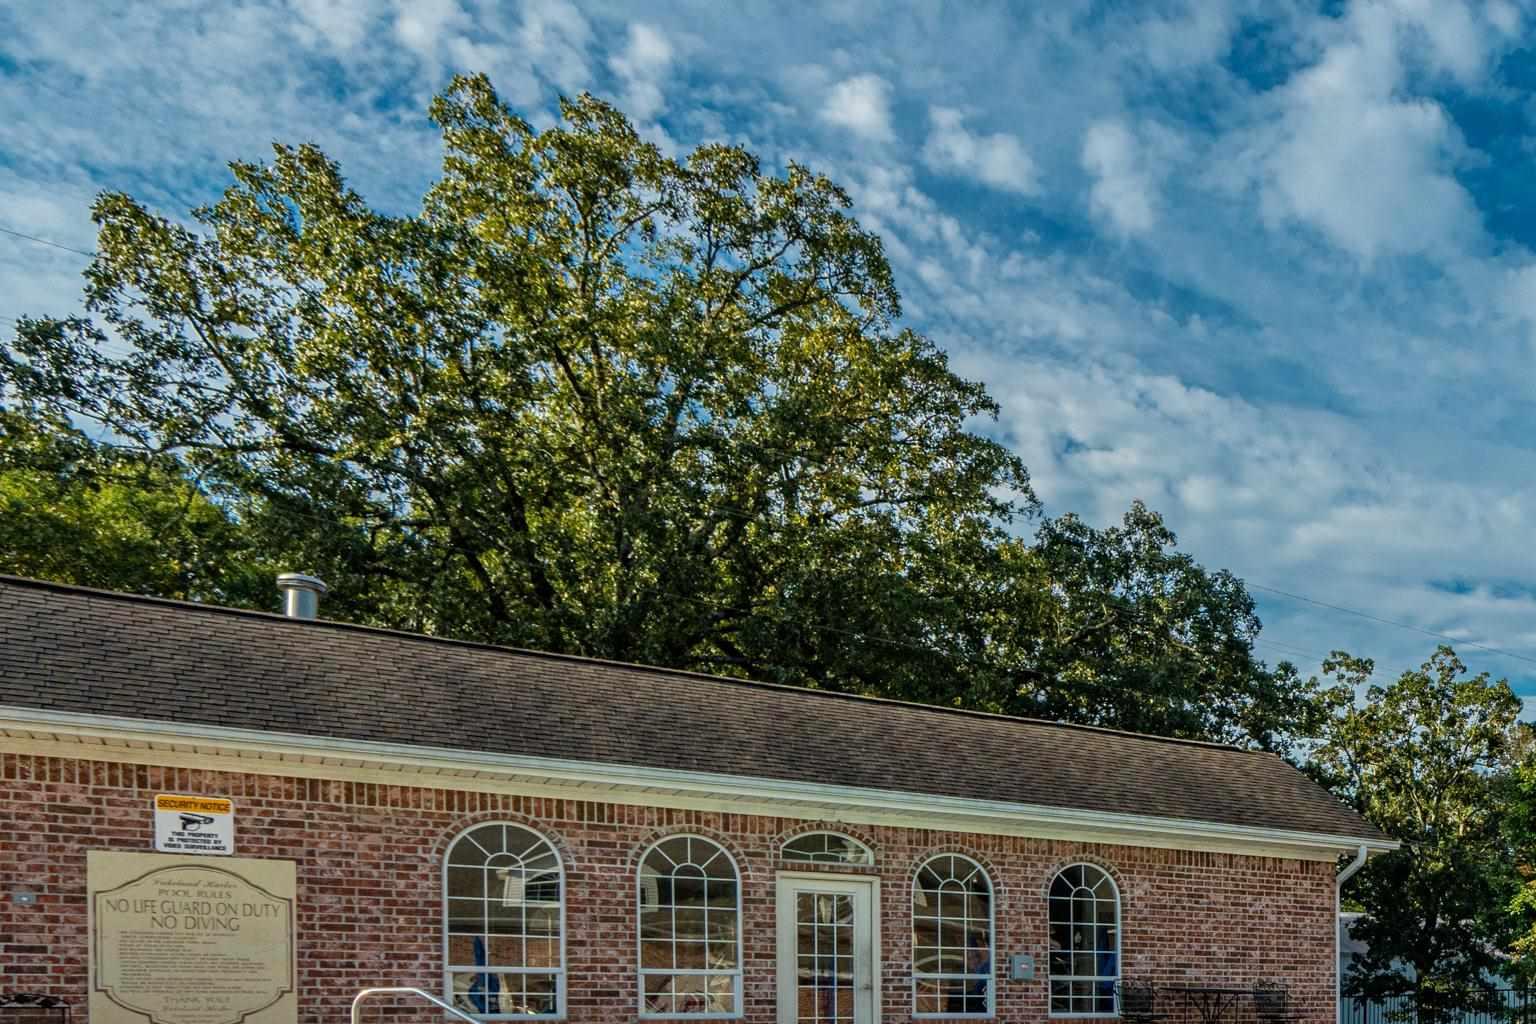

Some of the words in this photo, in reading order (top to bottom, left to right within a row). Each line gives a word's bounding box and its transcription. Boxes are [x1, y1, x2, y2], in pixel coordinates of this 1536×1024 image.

[158, 799, 199, 809] SECURITY
[200, 802, 231, 811] NOTICE
[158, 888, 193, 897] POOL
[196, 889, 232, 899] RULES
[105, 899, 129, 913] NO
[134, 899, 157, 914] LIFE
[160, 900, 212, 916] GUARD
[216, 902, 238, 916] ON
[242, 903, 281, 918] DUTY
[151, 915, 177, 930] NO
[184, 916, 240, 932] DIVING
